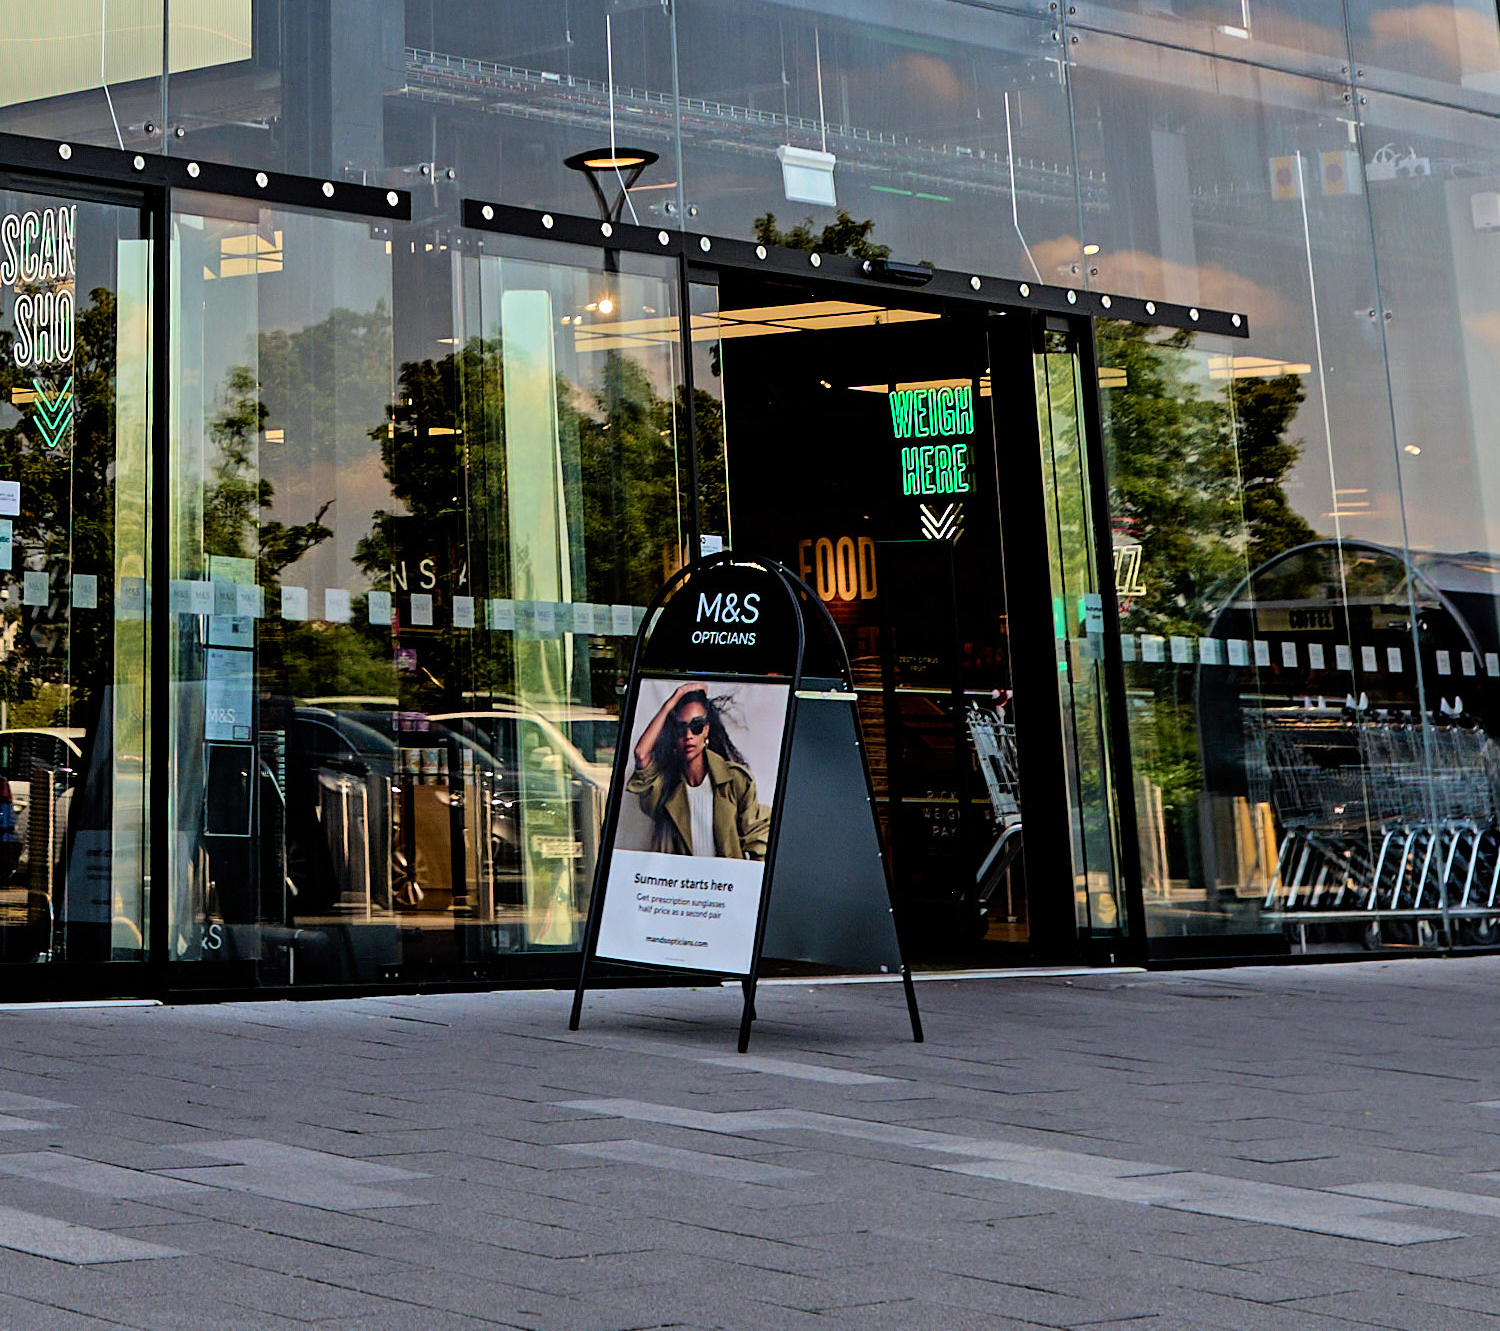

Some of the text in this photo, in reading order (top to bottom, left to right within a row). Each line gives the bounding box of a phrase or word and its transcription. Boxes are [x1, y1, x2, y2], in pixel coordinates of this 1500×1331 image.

[0, 204, 77, 286] SCAN
[13, 288, 76, 368] SHO
[888, 385, 975, 439] WEIGH
[901, 443, 970, 496] HERE
[798, 535, 878, 602] FOOD
[696, 592, 761, 624] M&S
[1288, 609, 1333, 629] COFFEE
[691, 630, 757, 646] OPTICIANS
[206, 707, 236, 724] M&S
[932, 825, 957, 837] PAY
[633, 873, 735, 893] Summer starts here
[636, 892, 726, 909] Get prescription sunglasses
[638, 904, 653, 914] half
[653, 906, 671, 916] price
[686, 909, 707, 919] second
[708, 911, 722, 920] pair
[645, 935, 709, 948] mandsopticians.com
